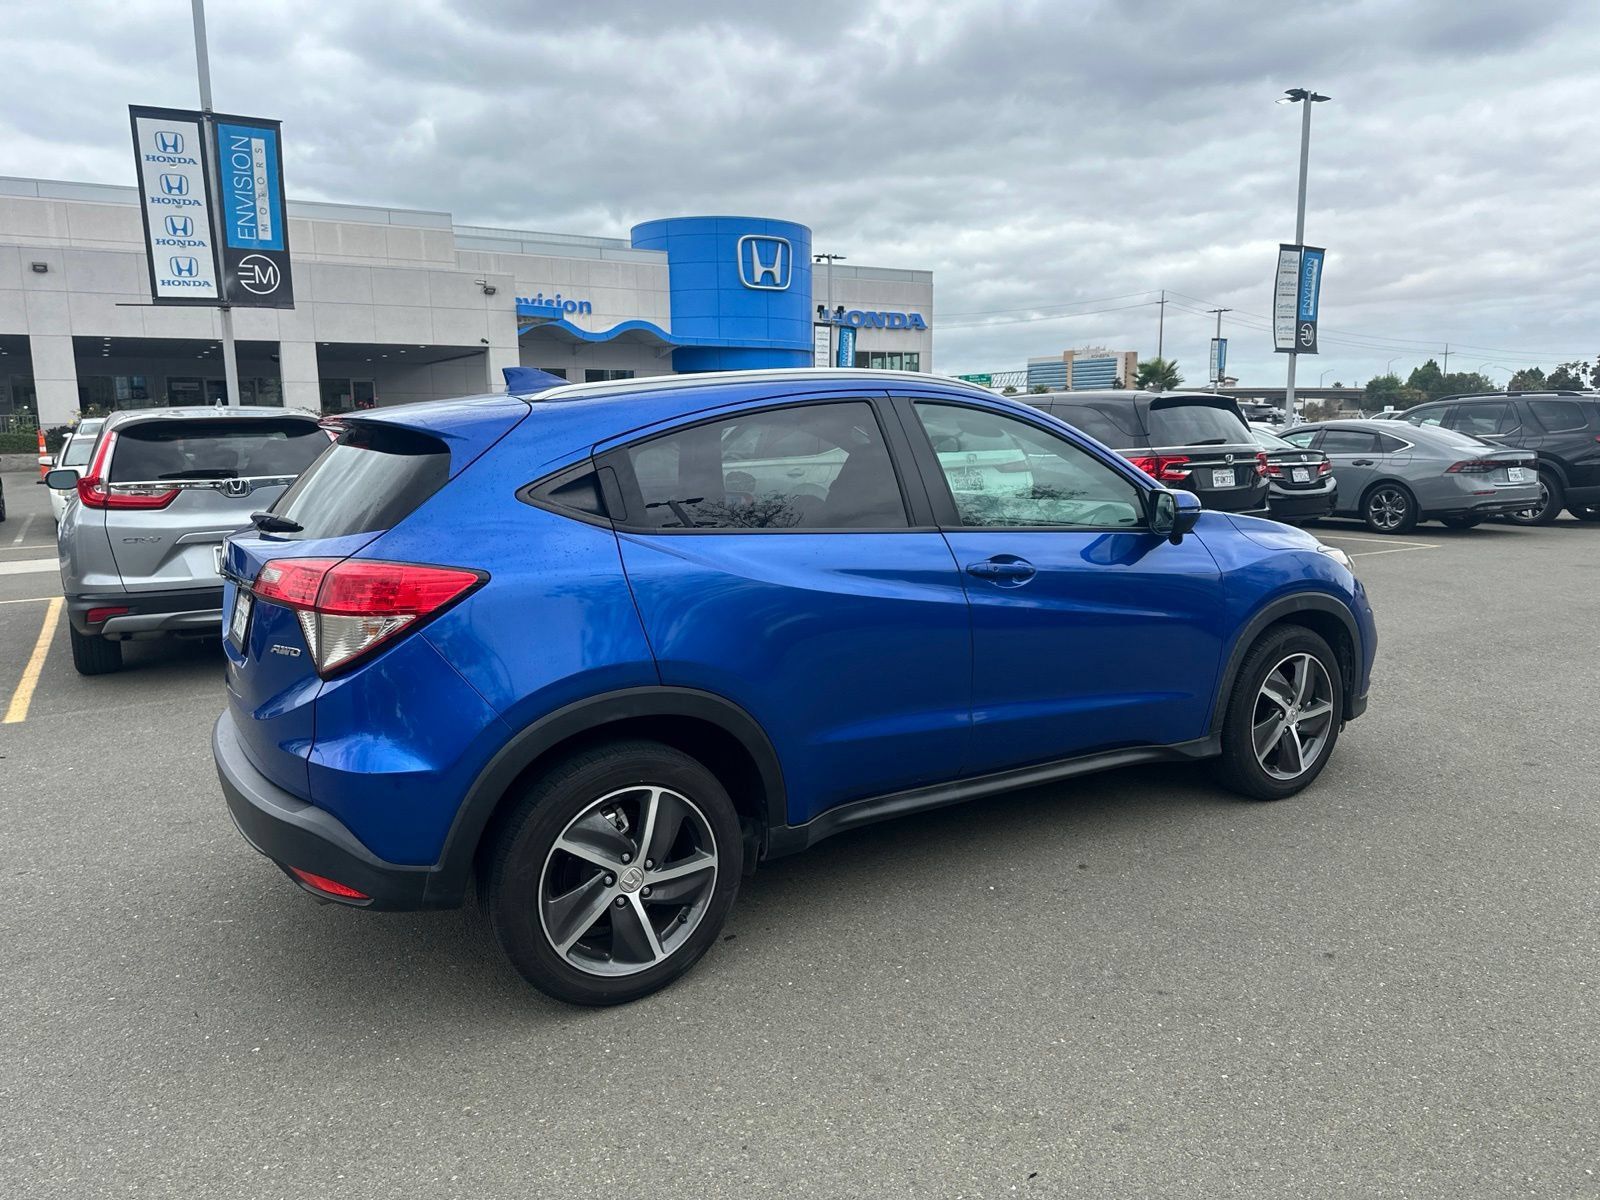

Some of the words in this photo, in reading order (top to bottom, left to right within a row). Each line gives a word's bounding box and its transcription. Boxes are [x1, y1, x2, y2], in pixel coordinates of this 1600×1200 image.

[145, 154, 198, 165] HONDA
[230, 135, 257, 240] ENVISION
[254, 147, 269, 232] MOTORS
[150, 196, 202, 206] HONDA
[155, 238, 207, 247] HONDA
[160, 279, 213, 287] HONDA
[1302, 257, 1315, 315] ENVISION
[270, 644, 302, 656] AWD
